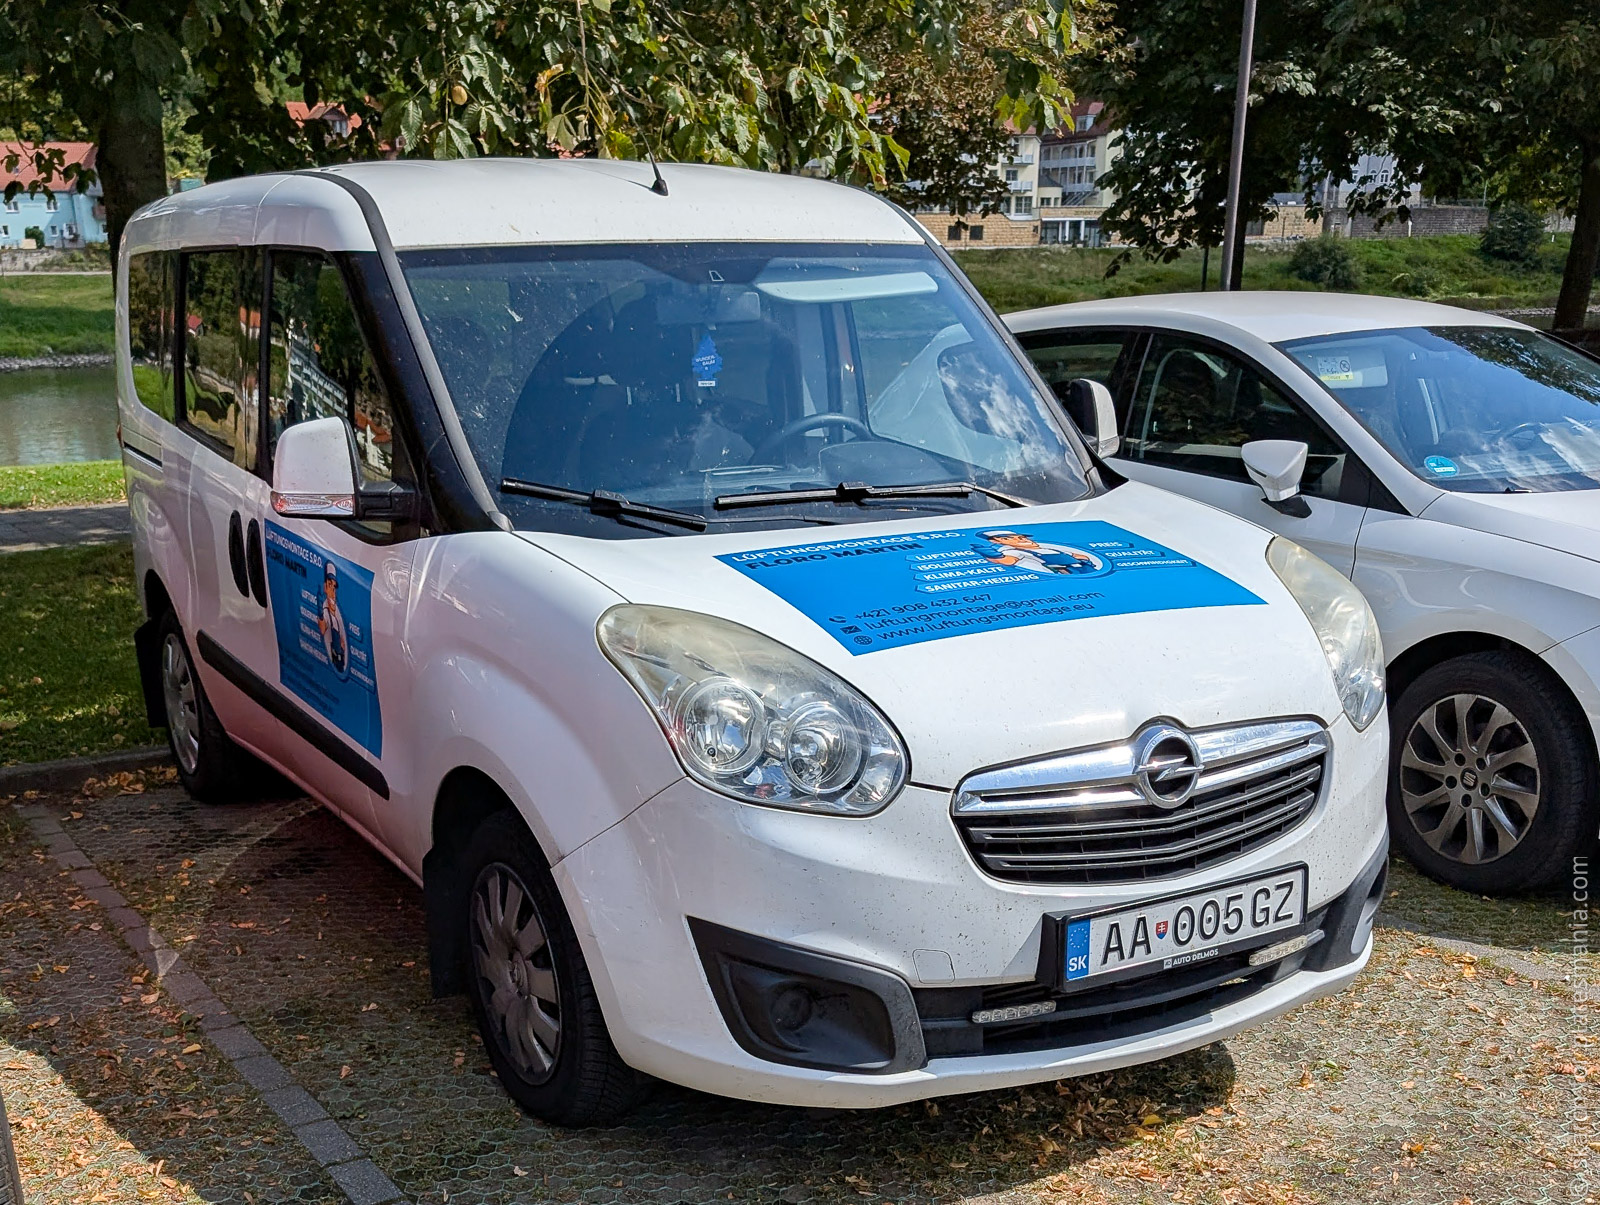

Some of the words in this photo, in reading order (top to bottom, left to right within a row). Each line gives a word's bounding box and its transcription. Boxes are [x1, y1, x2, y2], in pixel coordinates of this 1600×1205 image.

[732, 534, 917, 562] LÜFTUNGSMONTAGE
[919, 532, 966, 541] S.R.O.
[745, 554, 828, 570] FLORO
[830, 542, 925, 558] MARTIN
[917, 559, 988, 571] ISOLIERUNG
[855, 608, 891, 619] +421
[891, 602, 928, 613] 908
[930, 598, 962, 608] 432
[962, 593, 992, 604] 647
[864, 592, 1106, 630] luftungmontage@gmail.com
[876, 603, 1095, 640] www.luftungsmontage.eu
[1101, 915, 1152, 966] AA
[1068, 954, 1087, 973] SK
[1173, 956, 1191, 966] AUTO
[1192, 949, 1219, 961] DELMOS
